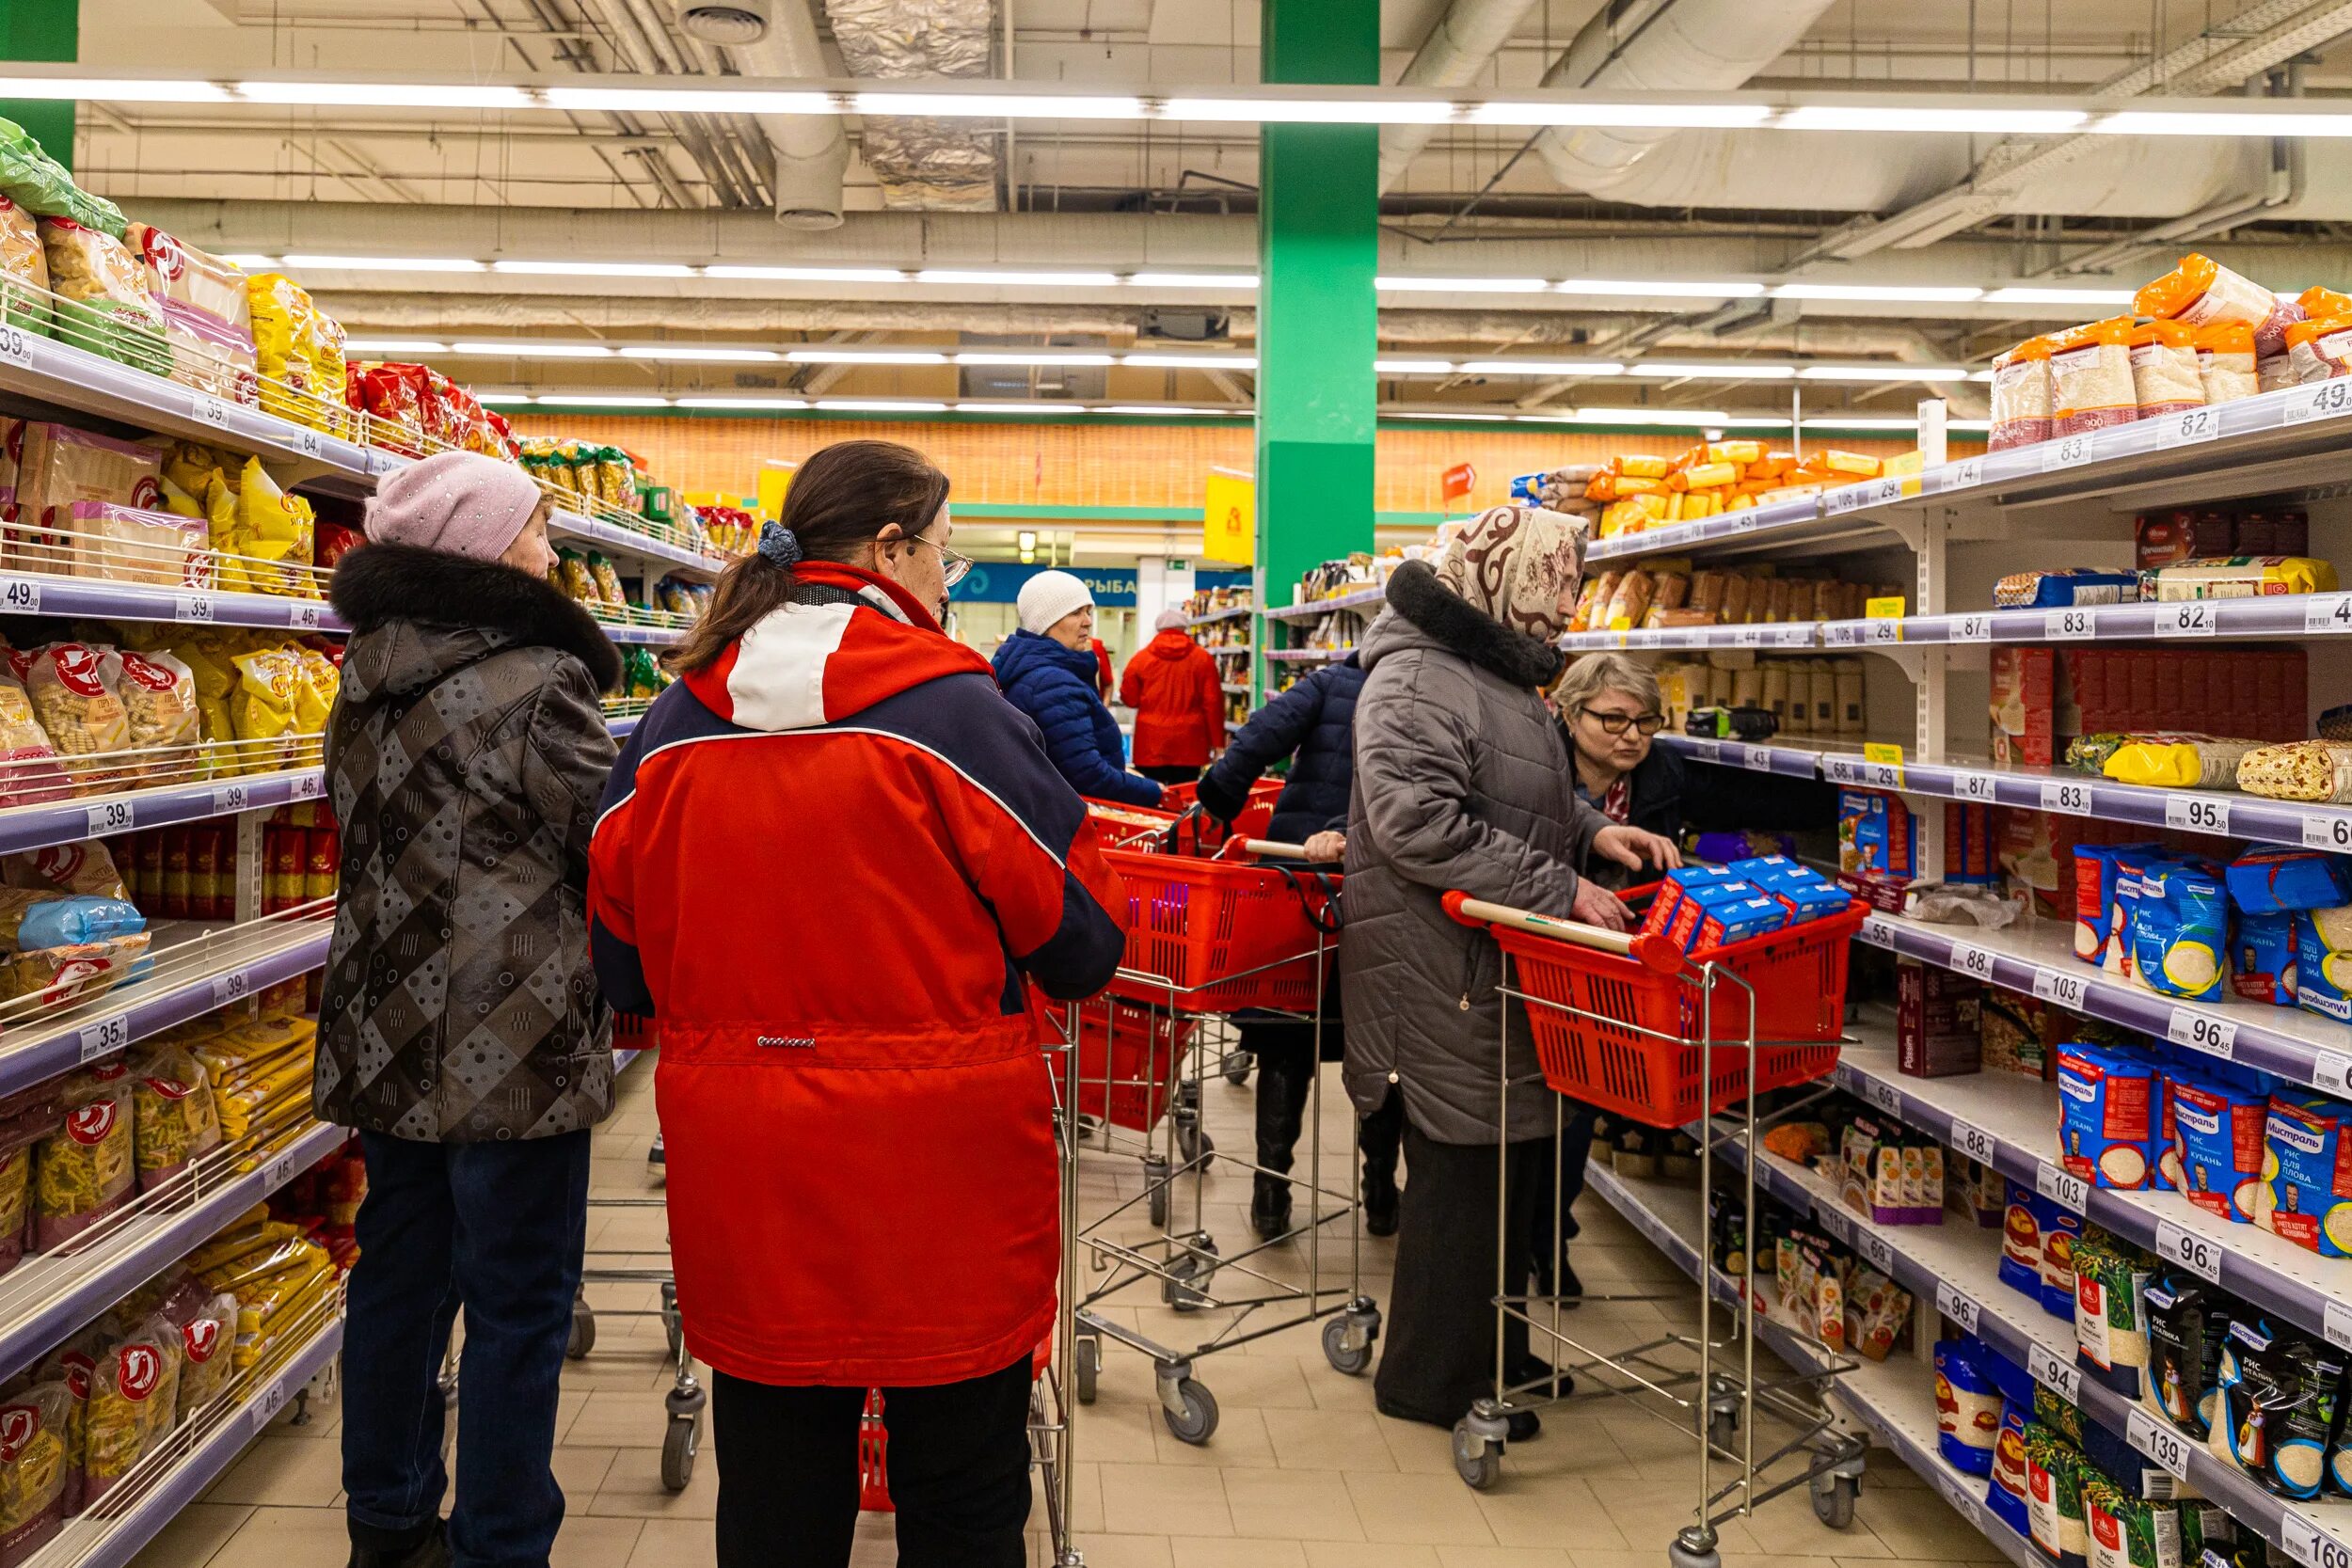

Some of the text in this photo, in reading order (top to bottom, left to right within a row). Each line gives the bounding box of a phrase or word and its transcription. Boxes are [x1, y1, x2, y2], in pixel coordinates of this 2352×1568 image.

[0, 329, 23, 356] 39
[2263, 323, 2280, 341] 900
[2312, 384, 2345, 411] 49
[207, 399, 222, 420] 39
[2084, 419, 2103, 427] 900
[2181, 412, 2207, 436] 82
[304, 434, 316, 451] 64
[2060, 438, 2081, 461] 83
[1957, 464, 1973, 483] 74
[1882, 481, 1896, 498] 29
[7, 582, 30, 605] 49
[1085, 578, 1137, 594] РЫБА
[191, 596, 206, 617] 39
[302, 608, 314, 625] 46
[2178, 605, 2204, 628] 82
[2334, 597, 2351, 623] 4
[1877, 623, 1891, 640] 29
[1965, 618, 1982, 636] 87
[2064, 612, 2085, 633] 83
[1835, 762, 1848, 779] 68
[1879, 767, 1893, 785] 29
[301, 778, 314, 794] 46
[1969, 777, 1986, 795] 87
[228, 787, 242, 807] 39
[2060, 786, 2081, 808] 83
[106, 803, 125, 827] 39
[2189, 801, 2216, 827] 95
[2217, 820, 2226, 830] 50
[1872, 924, 1888, 942] 55
[1967, 949, 1985, 972] 88
[228, 974, 243, 995] 39
[2053, 975, 2077, 1000] 103
[2299, 991, 2347, 1014] Мистраль
[100, 1022, 119, 1048] 35
[2193, 1019, 2221, 1047] 96
[2219, 1041, 2230, 1052] 45
[1878, 1086, 1894, 1107] 69
[2070, 1101, 2082, 1113] РИС
[2175, 1108, 2216, 1129] Мистраль
[1967, 1131, 1984, 1155] 88
[2189, 1133, 2203, 1146] РИС
[2267, 1121, 2319, 1148] Мистраль
[2190, 1151, 2222, 1166] КУБАНЬ
[2283, 1158, 2300, 1170] ДЛЯ
[2284, 1148, 2300, 1161] РИС
[276, 1159, 290, 1181] 46
[2282, 1166, 2312, 1183] ПЛОВА
[2056, 1175, 2079, 1204] 103
[1870, 1241, 1885, 1262] 69
[2181, 1237, 2217, 1275] 96 45
[1951, 1296, 1970, 1322] 96
[2153, 1315, 2167, 1328] РИС
[2152, 1324, 2181, 1342] ИТАЛИКА
[2230, 1323, 2265, 1348] Мистраль
[2243, 1356, 2261, 1371] РИС
[2048, 1361, 2069, 1391] 94
[264, 1389, 278, 1415] 46
[2150, 1430, 2178, 1465] 139
[2100, 1549, 2115, 1564] РИС
[2312, 1535, 2349, 1568] 169
